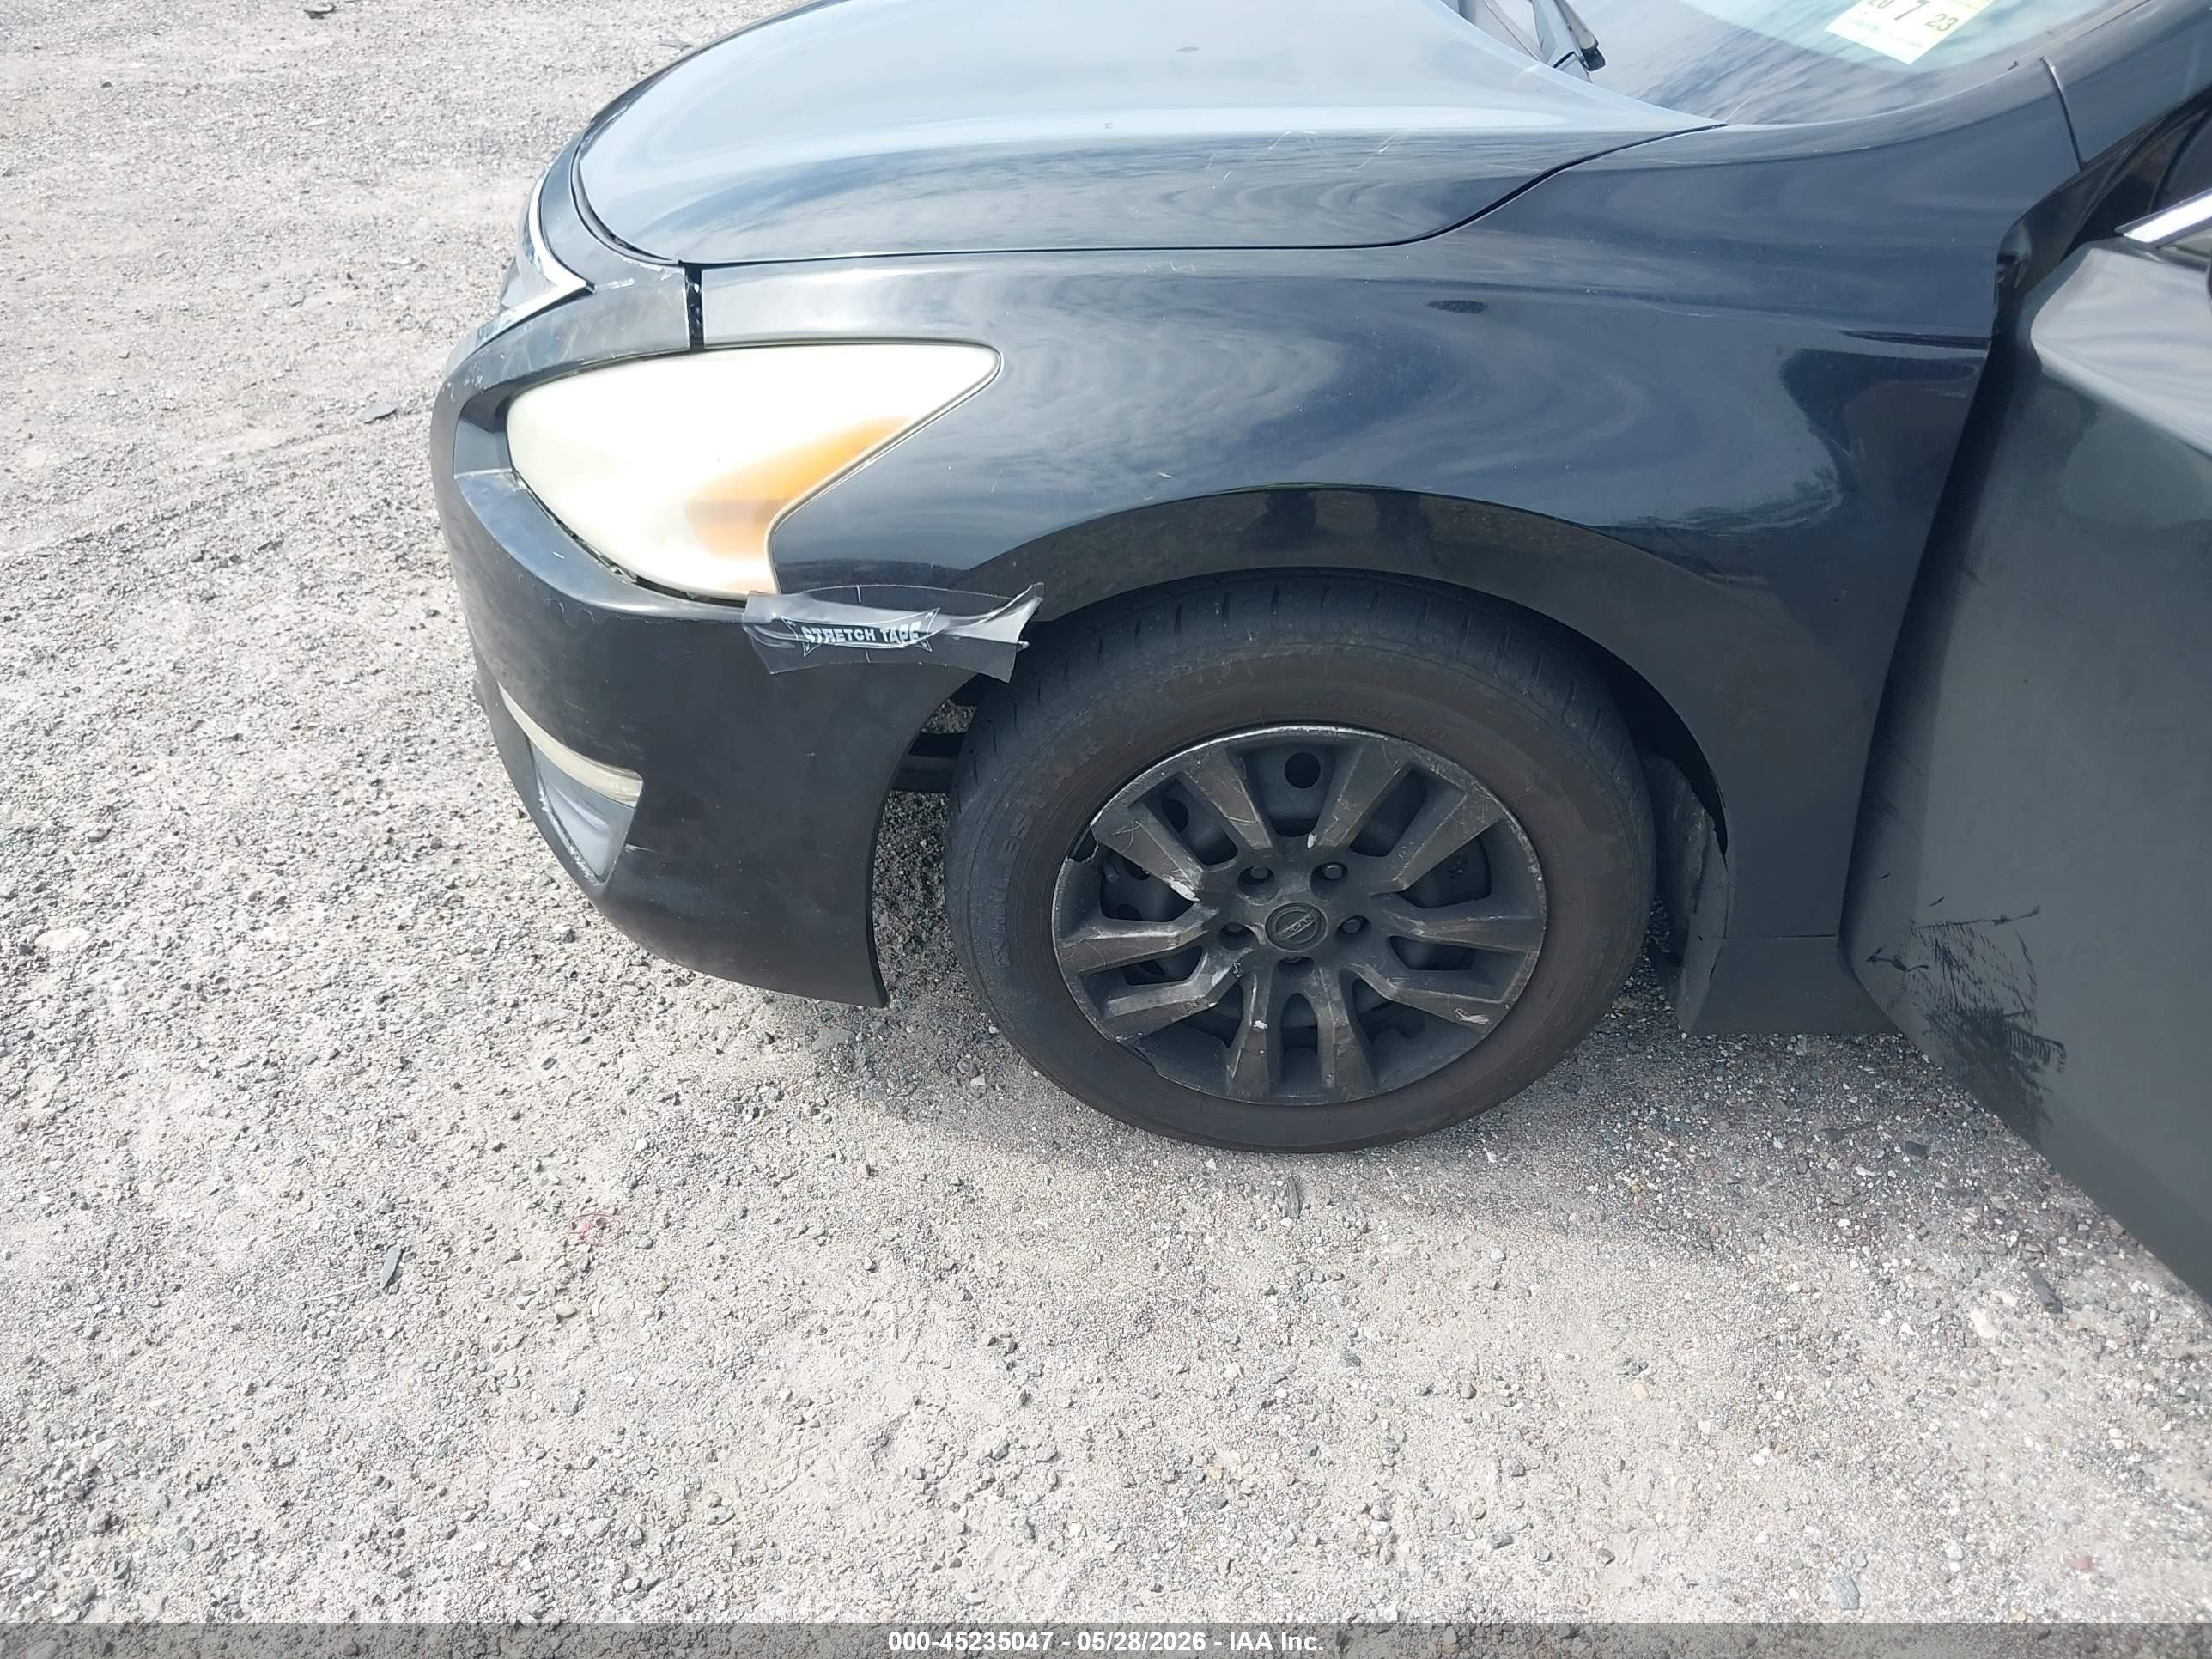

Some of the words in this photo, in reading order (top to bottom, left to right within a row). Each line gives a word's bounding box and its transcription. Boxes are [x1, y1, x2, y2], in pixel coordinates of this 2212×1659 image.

[1926, 13, 1959, 32] 23
[800, 626, 877, 644] STRETCH
[879, 621, 922, 644] TAPE
[1278, 914, 1315, 939] NISSAN
